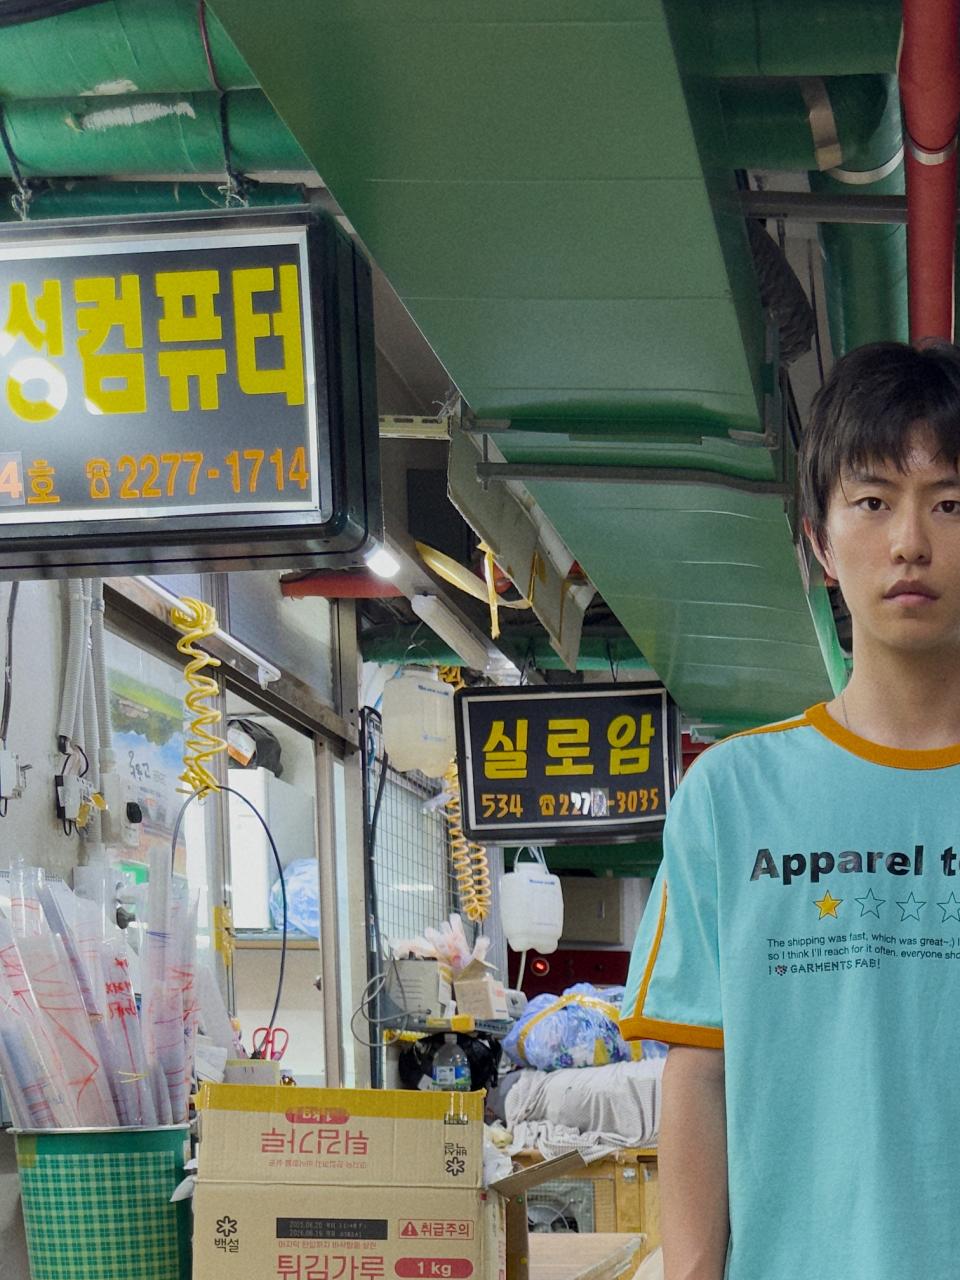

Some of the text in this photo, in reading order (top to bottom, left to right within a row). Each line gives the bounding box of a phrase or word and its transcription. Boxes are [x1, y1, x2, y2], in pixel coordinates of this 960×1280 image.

[2, 264, 305, 423] 성컴퓨터
[118, 447, 310, 499] 2277-1714
[482, 714, 656, 780] 실로암
[481, 793, 524, 818] 534
[749, 845, 924, 885] Apparel
[767, 938, 785, 948] The
[787, 935, 825, 947] shipping
[828, 934, 847, 943] was
[871, 933, 896, 945] which
[899, 937, 917, 946] was
[767, 952, 780, 961] so
[787, 949, 809, 959] think
[824, 945, 849, 957] reach
[851, 944, 864, 954] for
[866, 943, 871, 953] it
[900, 950, 943, 960] everyone
[790, 960, 853, 974] GARMENTS
[855, 958, 881, 969] FAB!
[261, 1127, 370, 1155] 튀김가루
[421, 1222, 470, 1237] 취급주의
[214, 1238, 239, 1253] 백설
[417, 1261, 452, 1277] 1 kg
